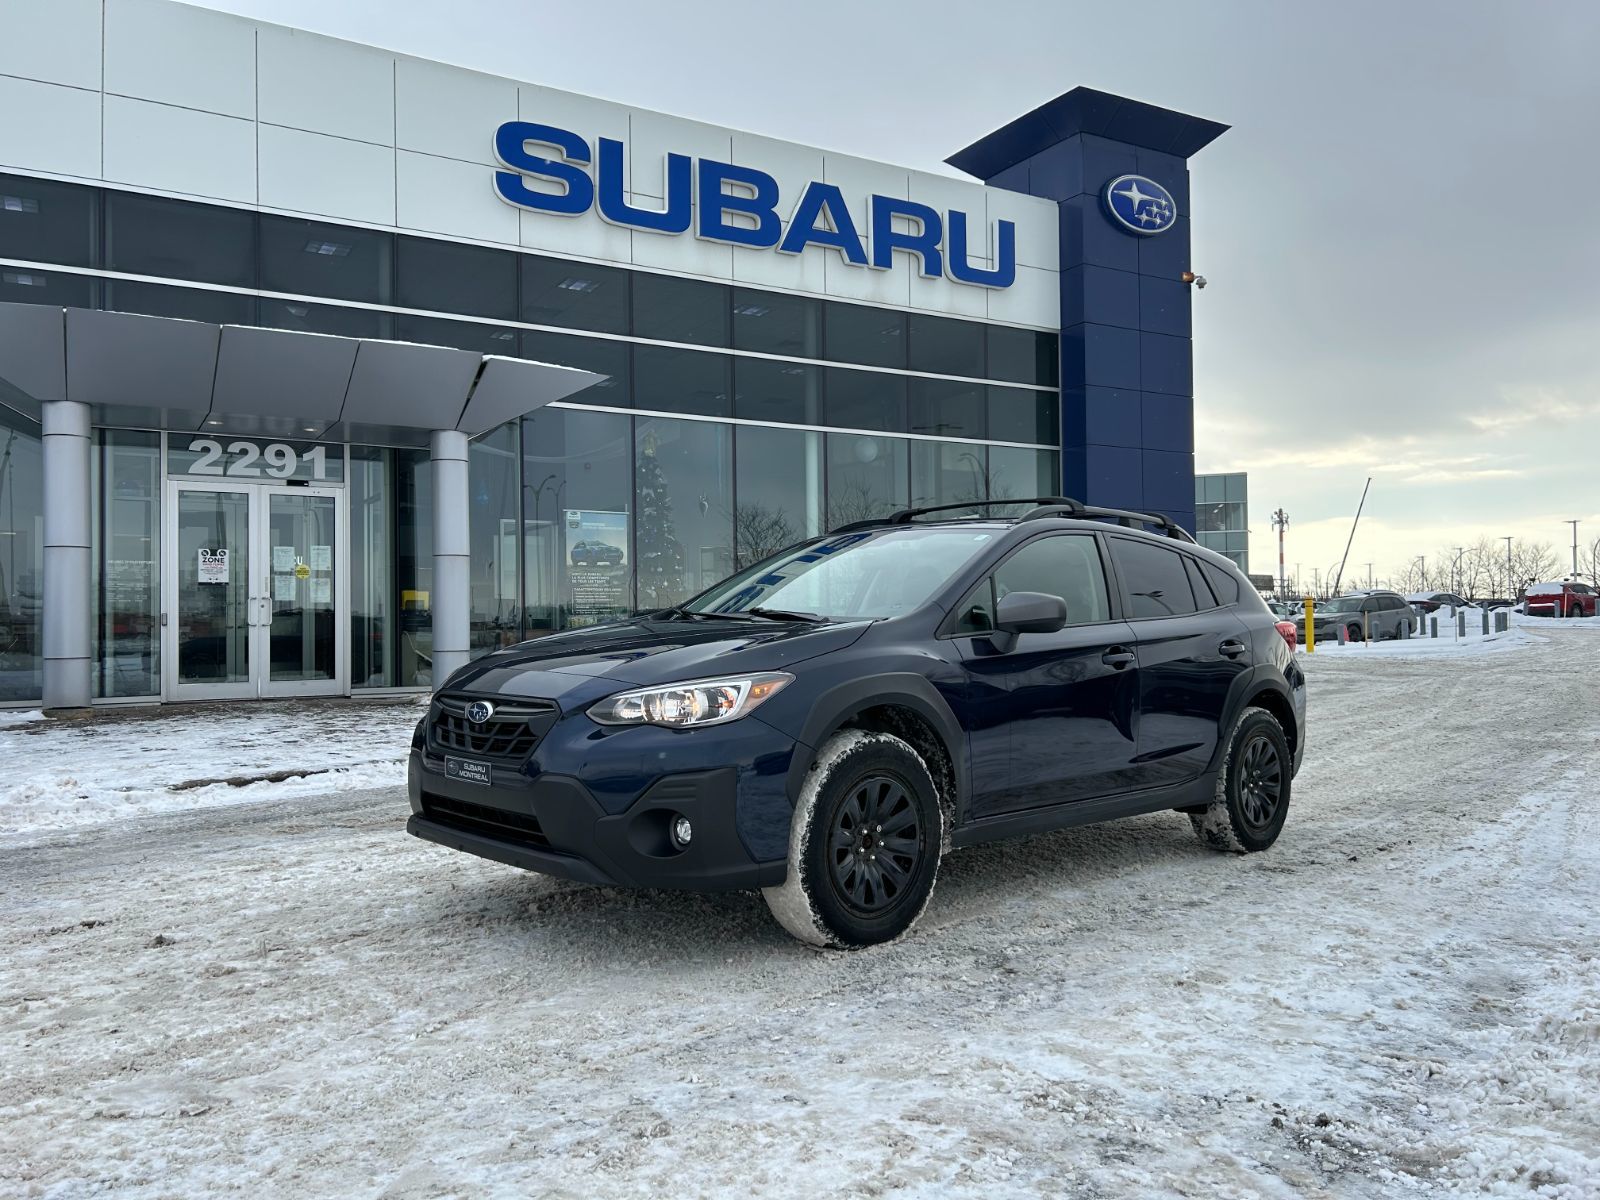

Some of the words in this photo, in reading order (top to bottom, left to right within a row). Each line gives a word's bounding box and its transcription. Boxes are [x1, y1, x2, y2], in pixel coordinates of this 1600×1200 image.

[493, 121, 1016, 290] SUBARU
[188, 440, 326, 479] 2291
[459, 770, 489, 781] MONTREAL
[463, 763, 486, 772] SUBARU
